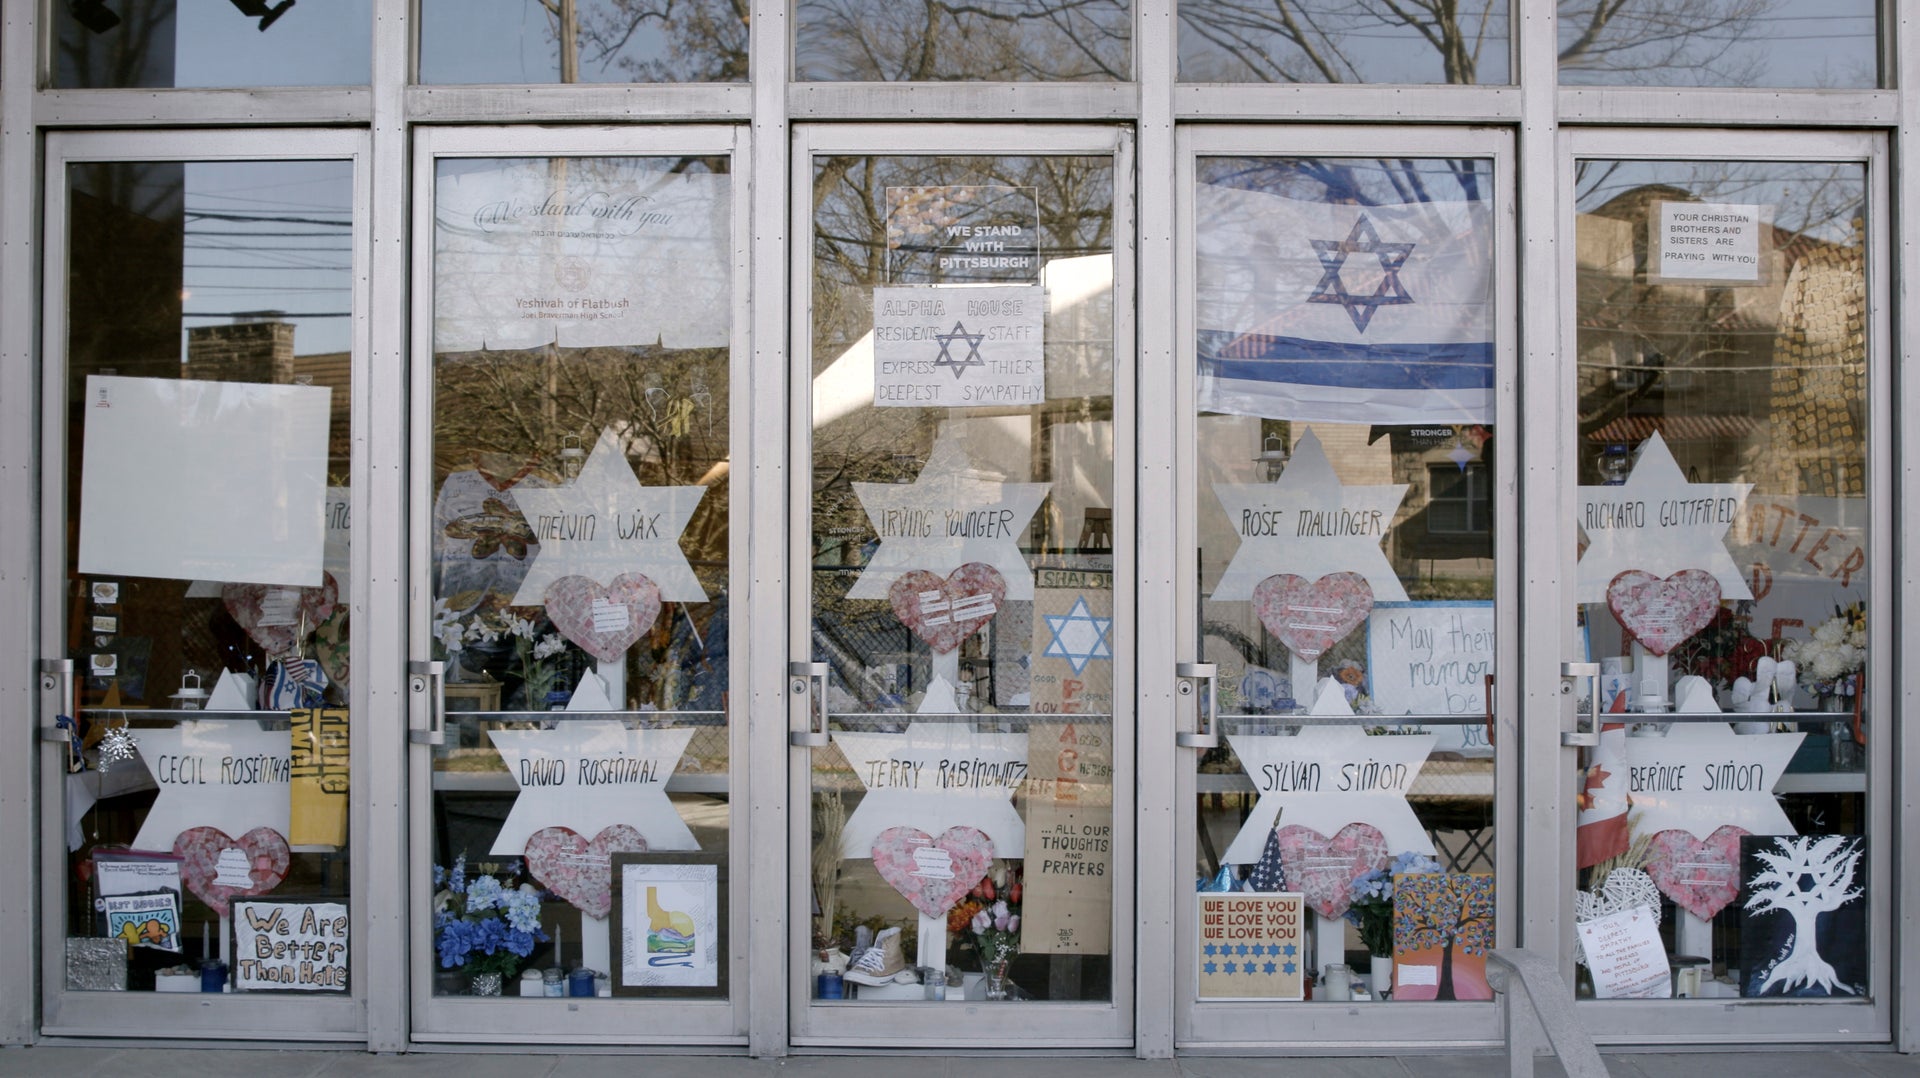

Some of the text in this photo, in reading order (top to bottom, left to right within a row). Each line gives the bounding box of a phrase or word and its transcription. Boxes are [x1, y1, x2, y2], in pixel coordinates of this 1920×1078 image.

[473, 190, 673, 236] We stand with you
[1673, 213, 1749, 223] YOUR CHRISTIAN
[947, 225, 1022, 237] WE STAND
[1670, 225, 1741, 235] BROTHERS AND
[965, 241, 1004, 252] WITH
[1670, 236, 1734, 246] SISTERS ARE
[940, 257, 1029, 269] PITTSBURGH
[1664, 252, 1756, 264] PRAYING WITH YOU
[516, 298, 630, 309] Yeshivah of Flatbush
[882, 299, 1024, 317] ALPHA HOUSE
[580, 311, 598, 321] High
[876, 325, 1033, 341] RESIDENTS STAFF
[882, 360, 1035, 375] EXPRESS THIER
[879, 384, 1043, 401] DEEPEST SYMPATHY
[1410, 429, 1453, 437] STRONGER
[881, 503, 1015, 539] IRVING YOUNGER
[1242, 504, 1383, 538] ROSE MALLINGER
[1585, 497, 1737, 530] RICHARD GOTTFRIED
[536, 509, 661, 542] MELVIN WAX
[1390, 616, 1433, 662] May
[1444, 687, 1482, 715] be
[158, 754, 207, 785] CECIL
[520, 751, 658, 786] DAVID ROSENTHAL
[865, 758, 1028, 789] JERRY RABINOWITZ
[1261, 758, 1407, 792] SYLVAN SIMON
[1630, 760, 1764, 793] BERNICE SIMON
[1055, 824, 1076, 835] ALL
[1083, 825, 1110, 836] OUR
[1041, 836, 1109, 852] THOUGHTS
[1064, 852, 1083, 860] AND
[1042, 859, 1105, 876] PRAYERS
[1204, 900, 1297, 913] WE LOVE YOU
[246, 907, 347, 938] We Are
[1204, 914, 1297, 926] WE LOVE YOU
[1204, 927, 1297, 939] WE LOVE YOU
[255, 936, 345, 963] Better
[240, 959, 347, 987] Than Hate
